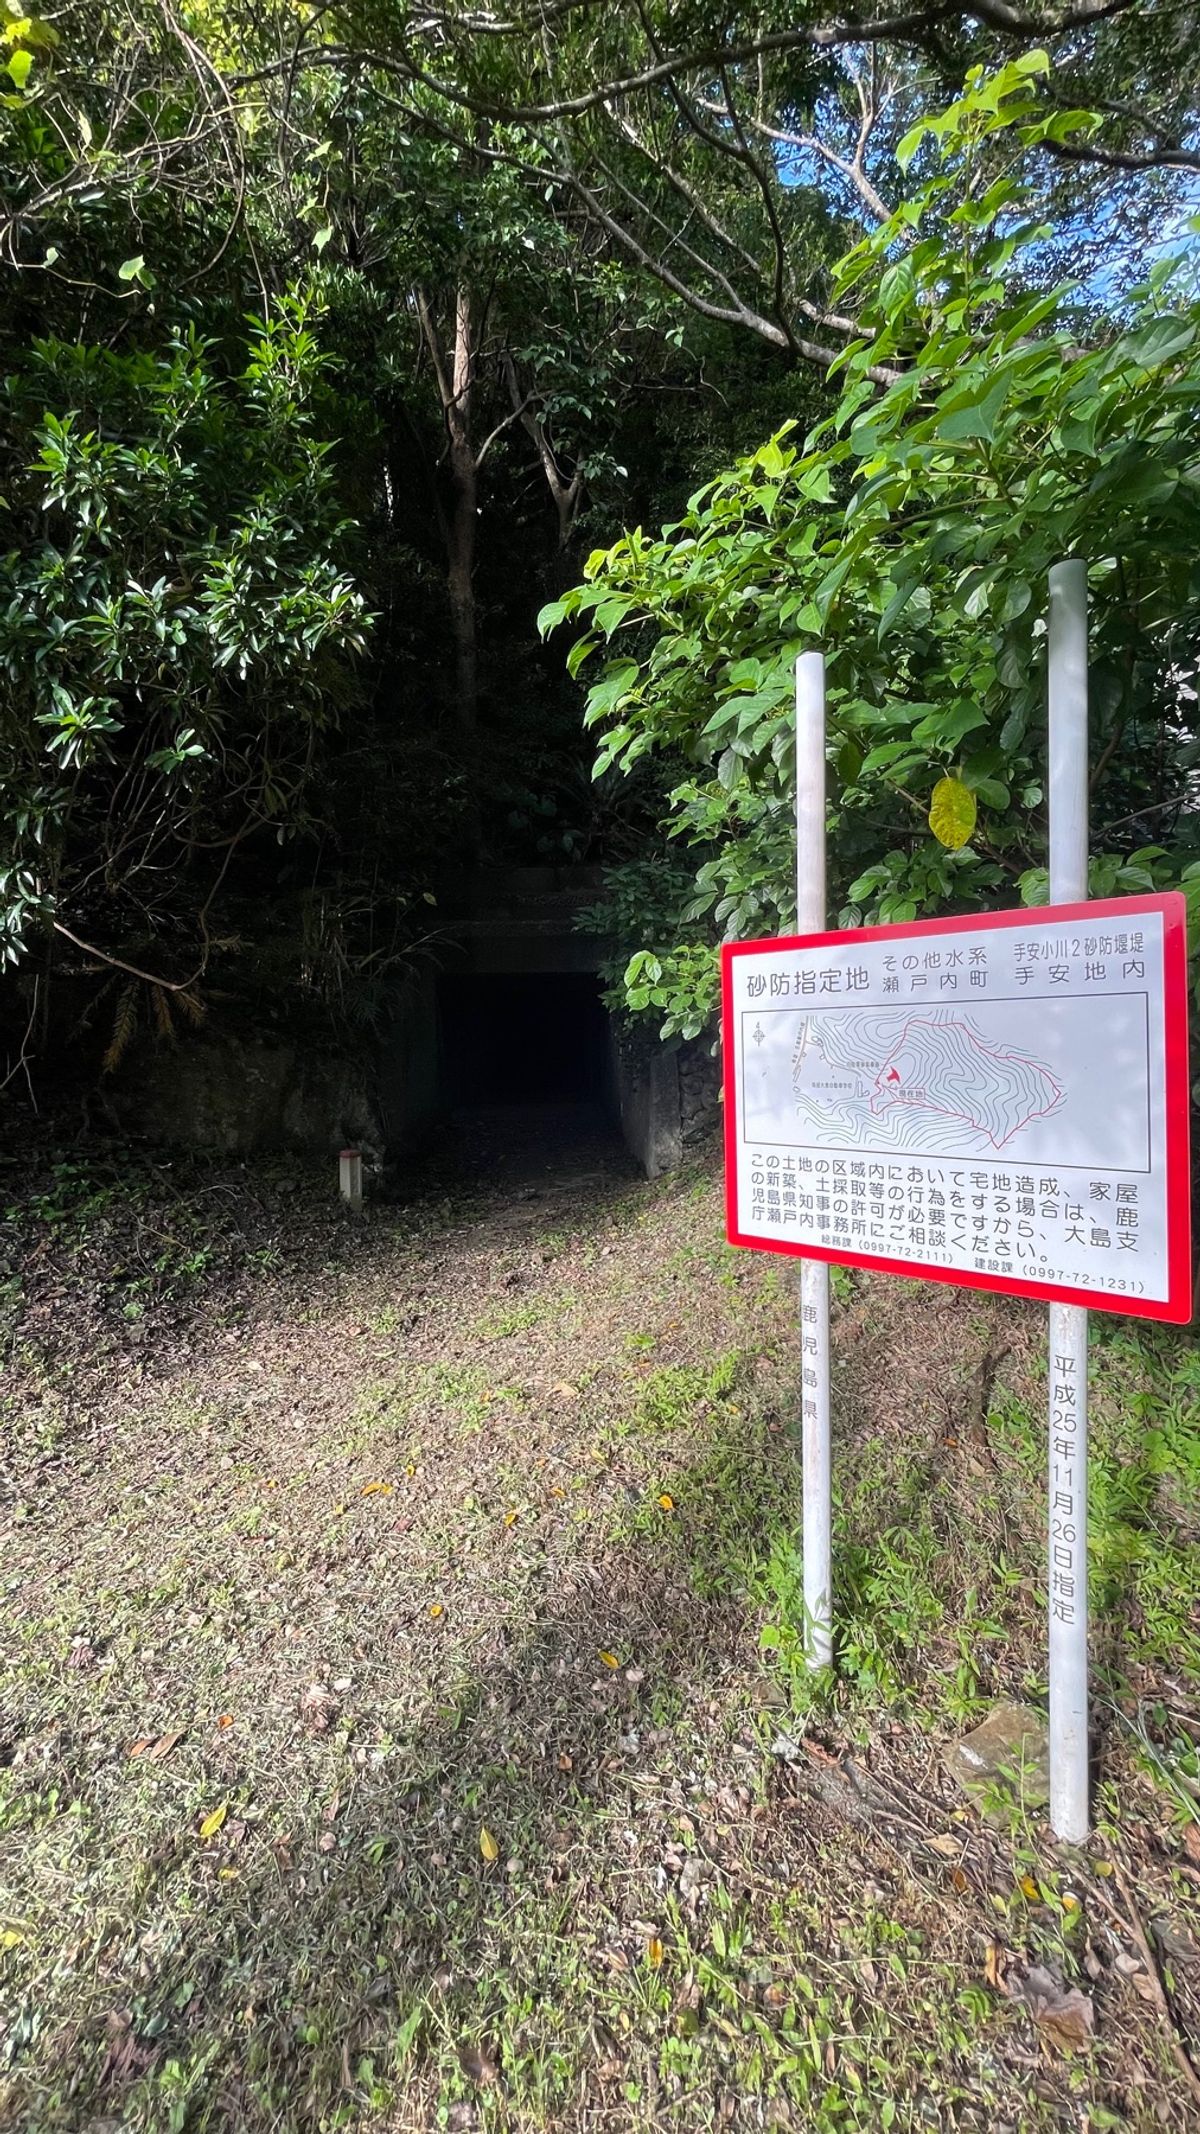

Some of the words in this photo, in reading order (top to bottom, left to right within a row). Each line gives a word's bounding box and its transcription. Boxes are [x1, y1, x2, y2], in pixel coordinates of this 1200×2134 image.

[882, 947, 987, 971] その他水系
[1013, 932, 1144, 962] 手安小川2砂防堰堤
[1014, 959, 1145, 985] 手安地内
[747, 966, 870, 998] 砂防指定地
[882, 970, 987, 993] 瀬戸内町
[751, 1153, 1139, 1204] この土地の区域内において宅地造成、家屋
[751, 1171, 1139, 1229] の新築、土採取等の行為をする場合は、鹿
[751, 1188, 1139, 1253] 児島県知事の許可が必要ですから、大島支
[751, 1205, 1049, 1263] 庁瀬戸内事務所にご相談ください。
[803, 1305, 818, 1420] 鹿児島県
[1052, 1354, 1077, 1626] 平成25年11月26日指定
